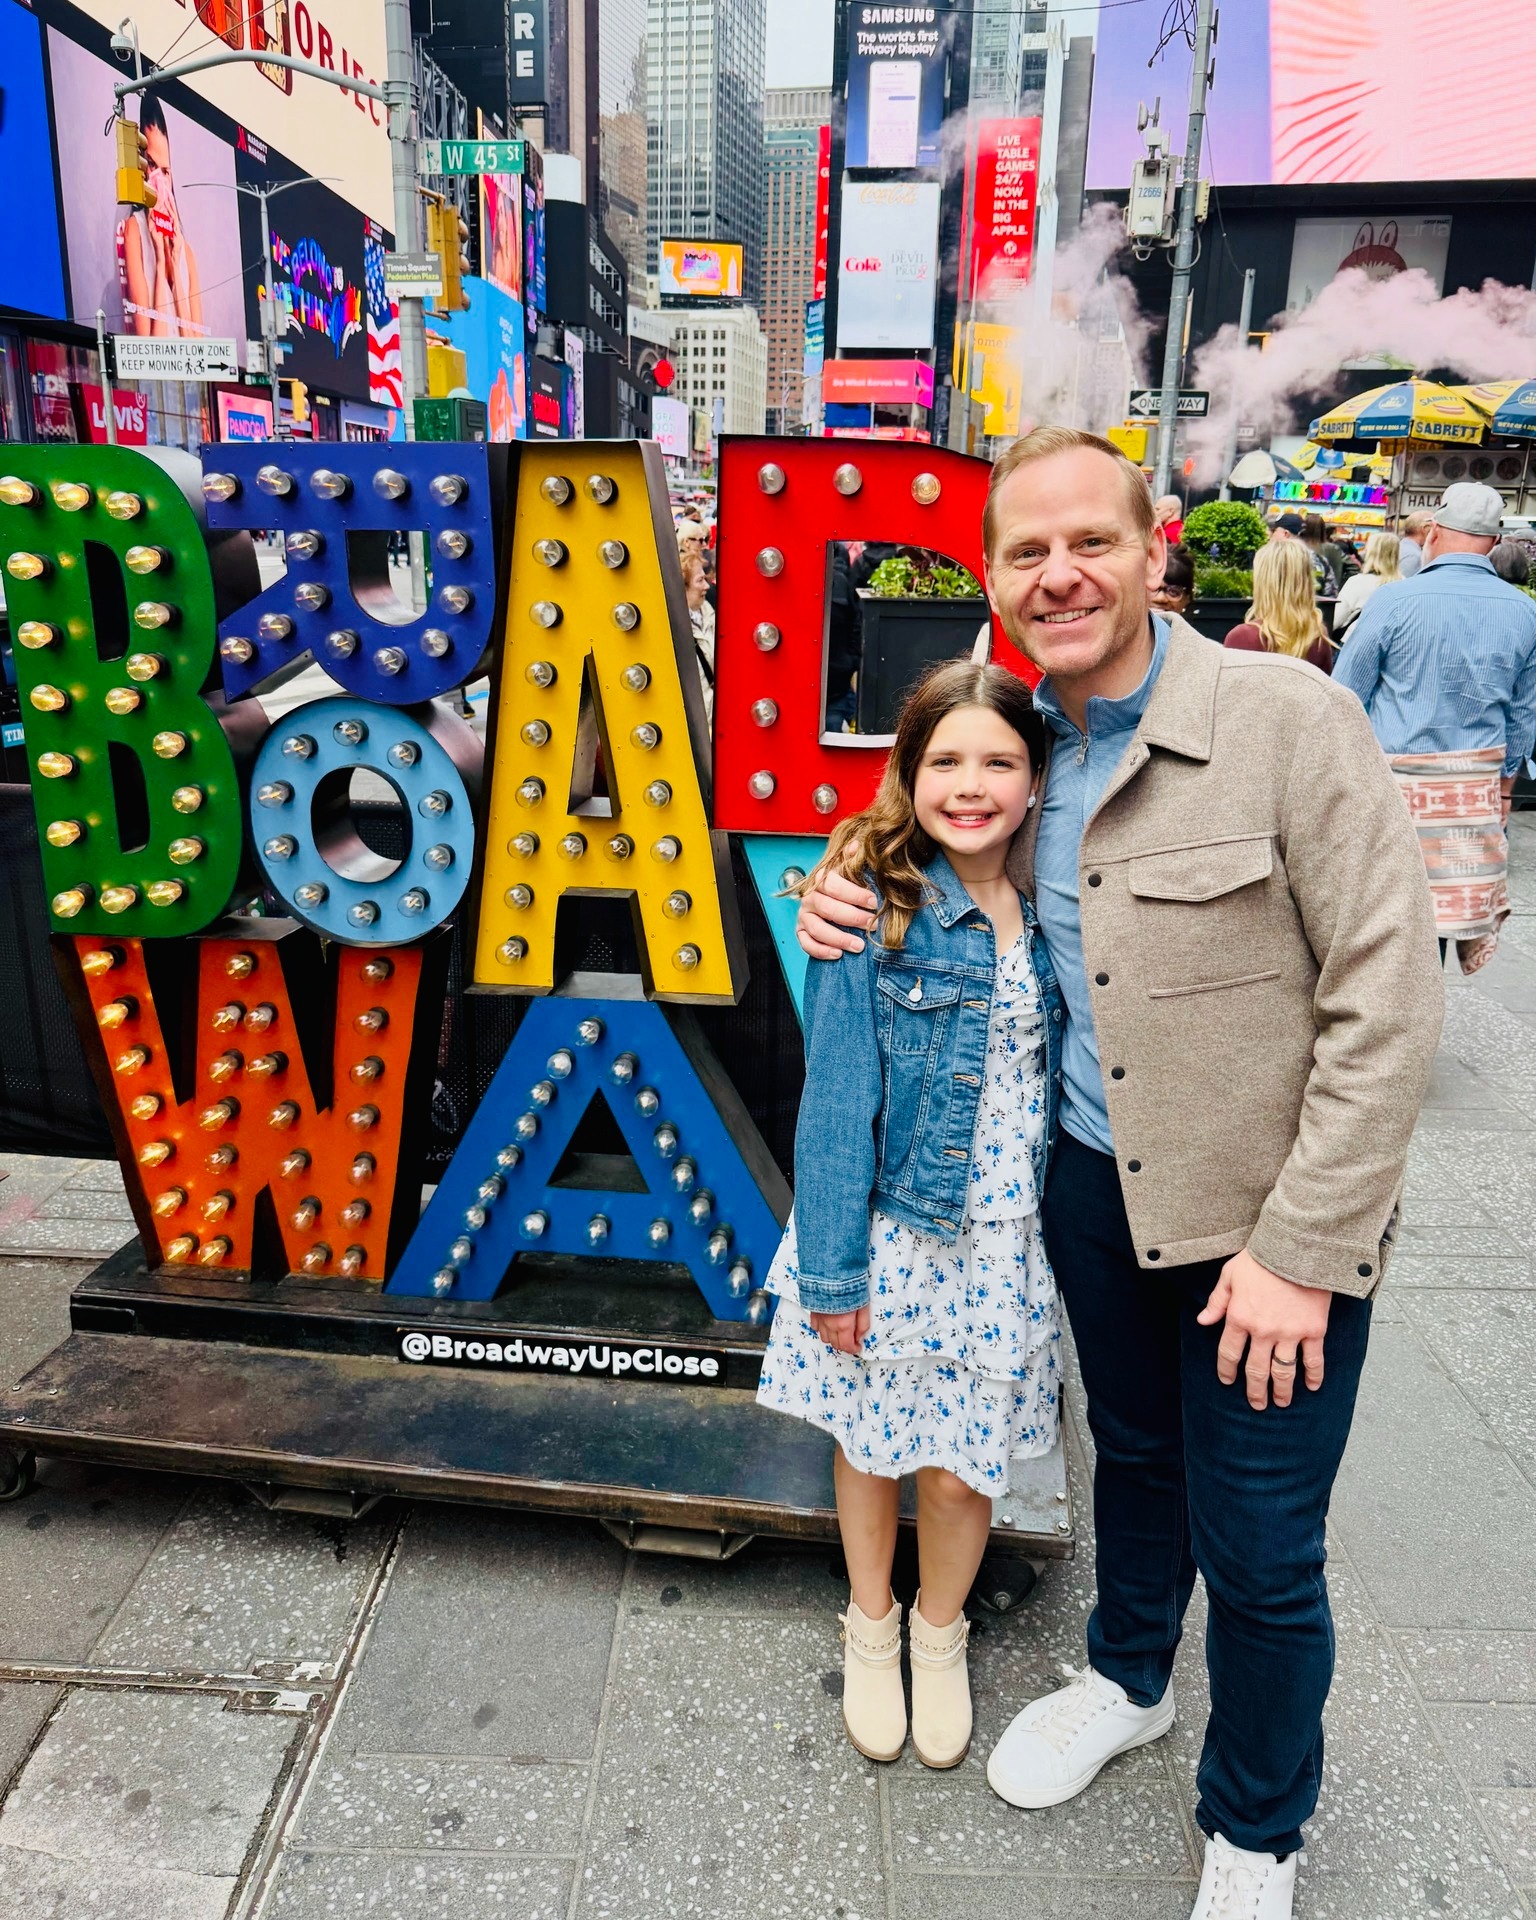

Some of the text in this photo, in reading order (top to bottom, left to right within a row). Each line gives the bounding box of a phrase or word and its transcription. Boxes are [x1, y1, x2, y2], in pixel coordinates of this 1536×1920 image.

[862, 8, 935, 24] SAMSUNG
[511, 0, 537, 78] RE
[857, 30, 939, 43] The world's first
[858, 42, 936, 58] Privacy Display
[997, 135, 1020, 146] LIVE
[446, 145, 520, 170] W 45 St
[997, 148, 1029, 159] TABLE
[995, 160, 1035, 172] GAMES
[995, 174, 1023, 186] 24/7,
[994, 186, 1024, 198] NOW
[993, 199, 1028, 210] IN THE
[992, 212, 1011, 223] BIG
[991, 225, 1028, 236] APPLE.
[386, 263, 432, 274] Times Square
[845, 256, 882, 272] Coke
[386, 273, 439, 281] Pedestrian Plaza
[120, 343, 231, 357] PEDESTRIAN FLOW ZONE
[121, 360, 183, 372] KEEP MOVING
[1139, 398, 1162, 409] ONE
[92, 402, 144, 433] LVI'S
[1415, 421, 1479, 439] SABRETT
[1407, 494, 1442, 507] HALA
[401, 1332, 719, 1378] @BroadwayUpClose
